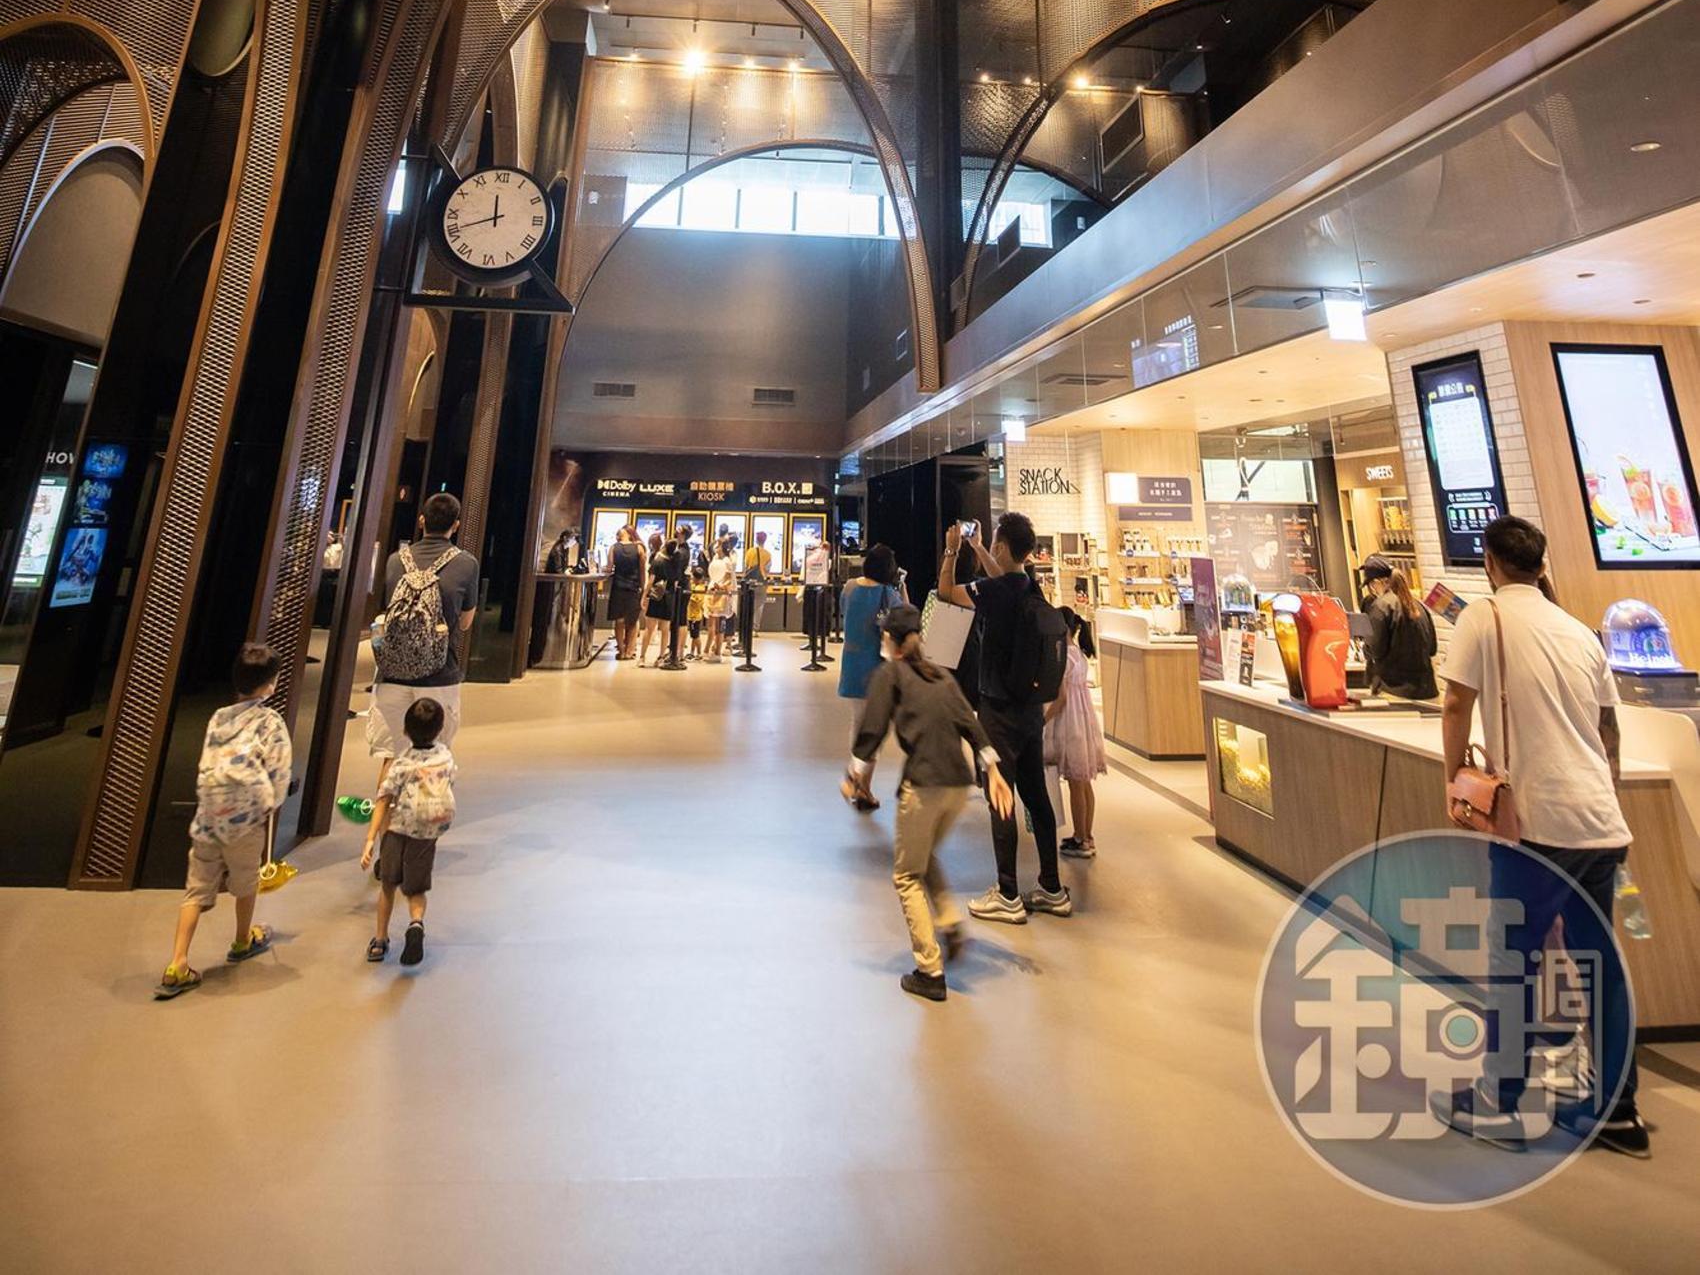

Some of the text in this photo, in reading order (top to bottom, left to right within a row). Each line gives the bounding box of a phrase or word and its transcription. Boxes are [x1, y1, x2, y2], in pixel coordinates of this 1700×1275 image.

[472, 175, 487, 187] XI
[495, 173, 511, 183] XII
[457, 189, 469, 199] X
[530, 196, 542, 205] II
[447, 208, 459, 220] IX
[532, 215, 543, 226] III
[483, 254, 495, 265] VI
[505, 251, 515, 263] V
[1020, 468, 1061, 482] SNACK
[610, 479, 675, 493] Dolby LUXE
[1020, 479, 1070, 495] STATION
[698, 492, 725, 502] KIOSK
